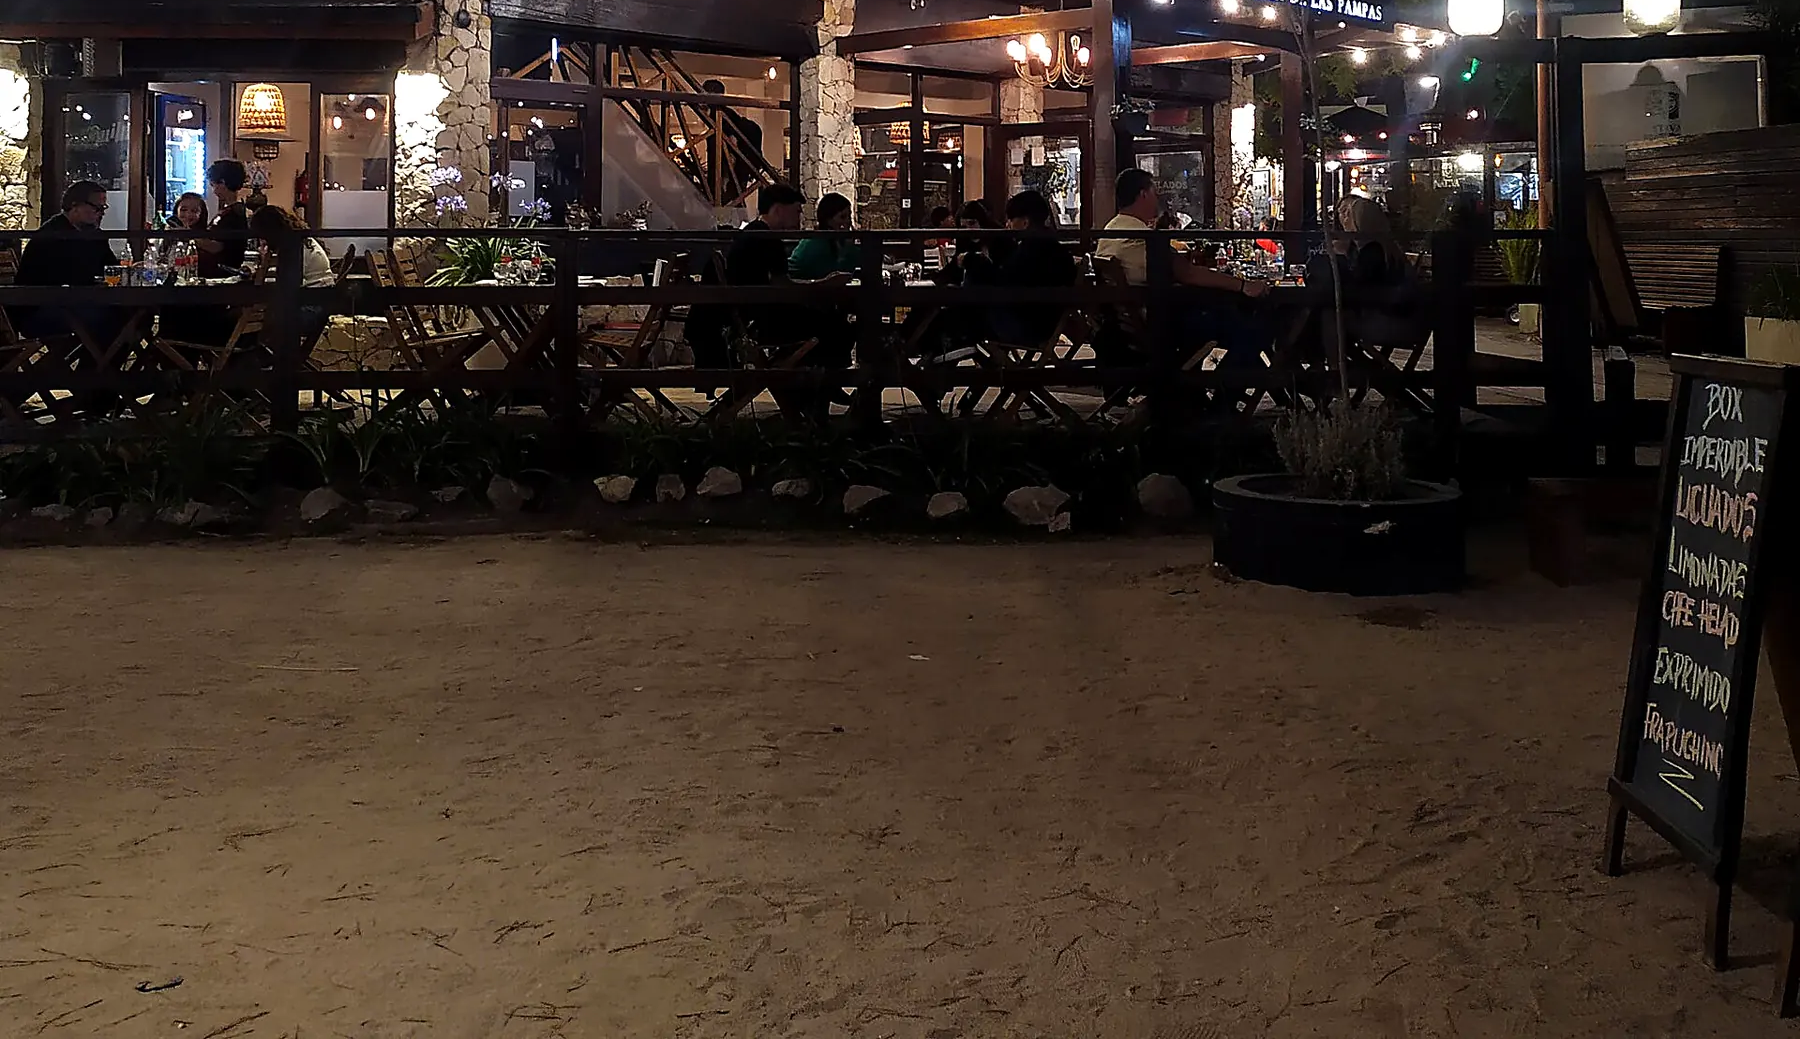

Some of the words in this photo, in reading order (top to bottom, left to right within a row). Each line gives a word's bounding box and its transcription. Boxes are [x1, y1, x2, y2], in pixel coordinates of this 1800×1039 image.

[1702, 383, 1743, 431] BOX
[1680, 434, 1768, 489] IMPERDIBLE
[1675, 475, 1759, 543] LICUADOS
[1668, 526, 1748, 600] LIMONADAS
[1652, 646, 1732, 718] EXPRIMIDO
